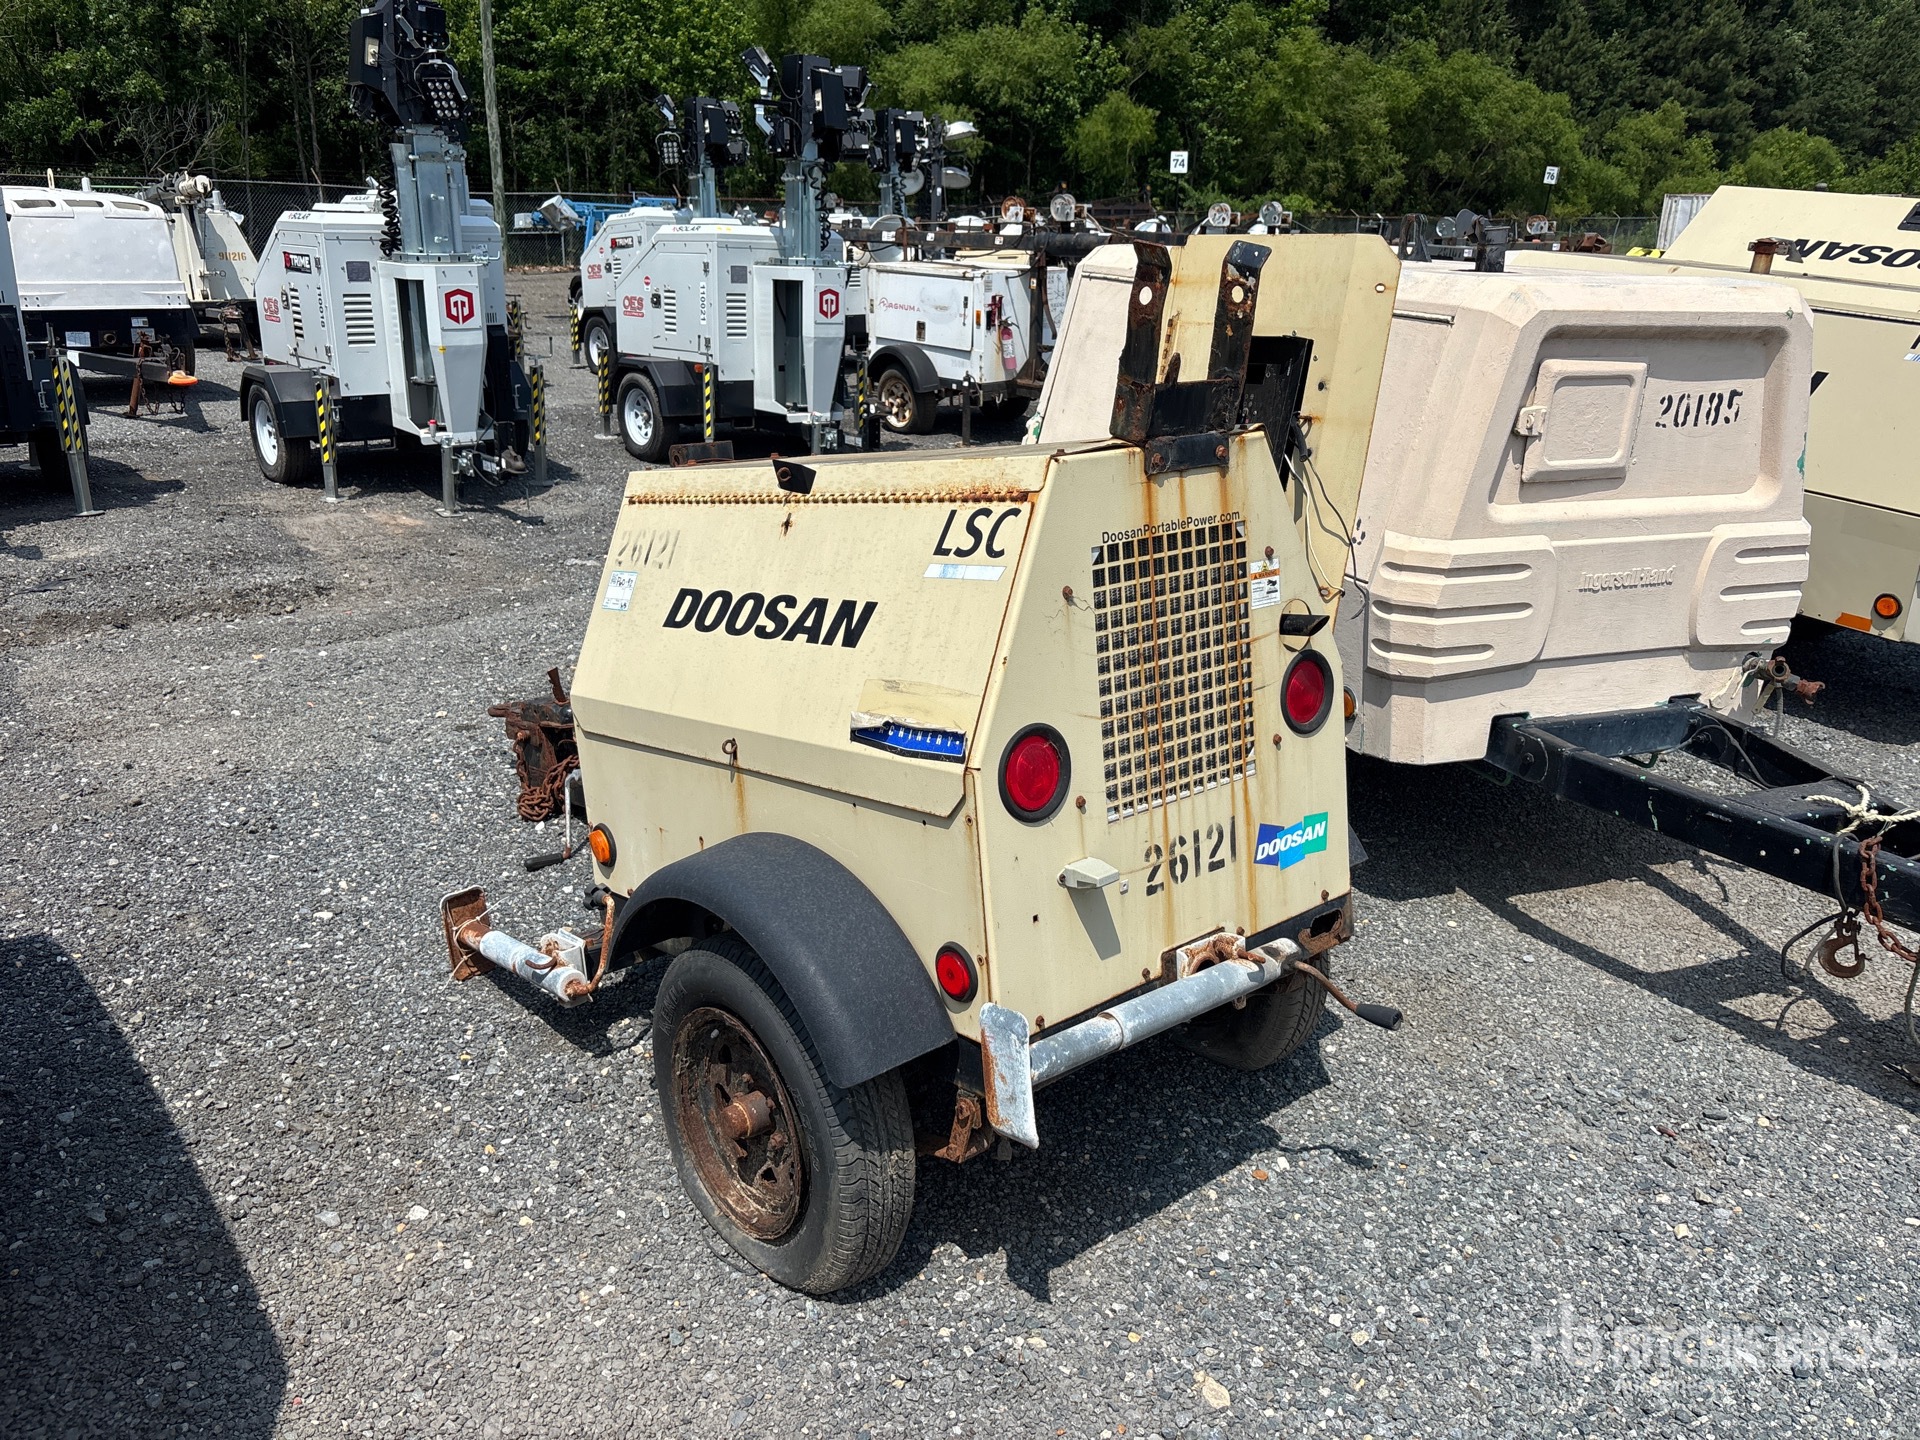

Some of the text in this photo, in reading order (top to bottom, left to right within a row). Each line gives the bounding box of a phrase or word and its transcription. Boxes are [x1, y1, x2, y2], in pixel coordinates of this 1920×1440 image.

[1172, 158, 1186, 169] 74
[1546, 171, 1556, 181] 76
[616, 237, 633, 247] TRIME
[290, 254, 311, 268] TRIME
[587, 264, 602, 275] OES
[622, 296, 644, 311] OES
[1655, 389, 1743, 428] 20185
[932, 507, 1022, 558] LSC
[1101, 511, 1241, 544] DoosanPortablePower.com
[615, 530, 681, 569] 26121
[662, 587, 879, 649] DOOSAN
[1144, 815, 1237, 897] 26121
[1256, 821, 1326, 861] DOOSAN
